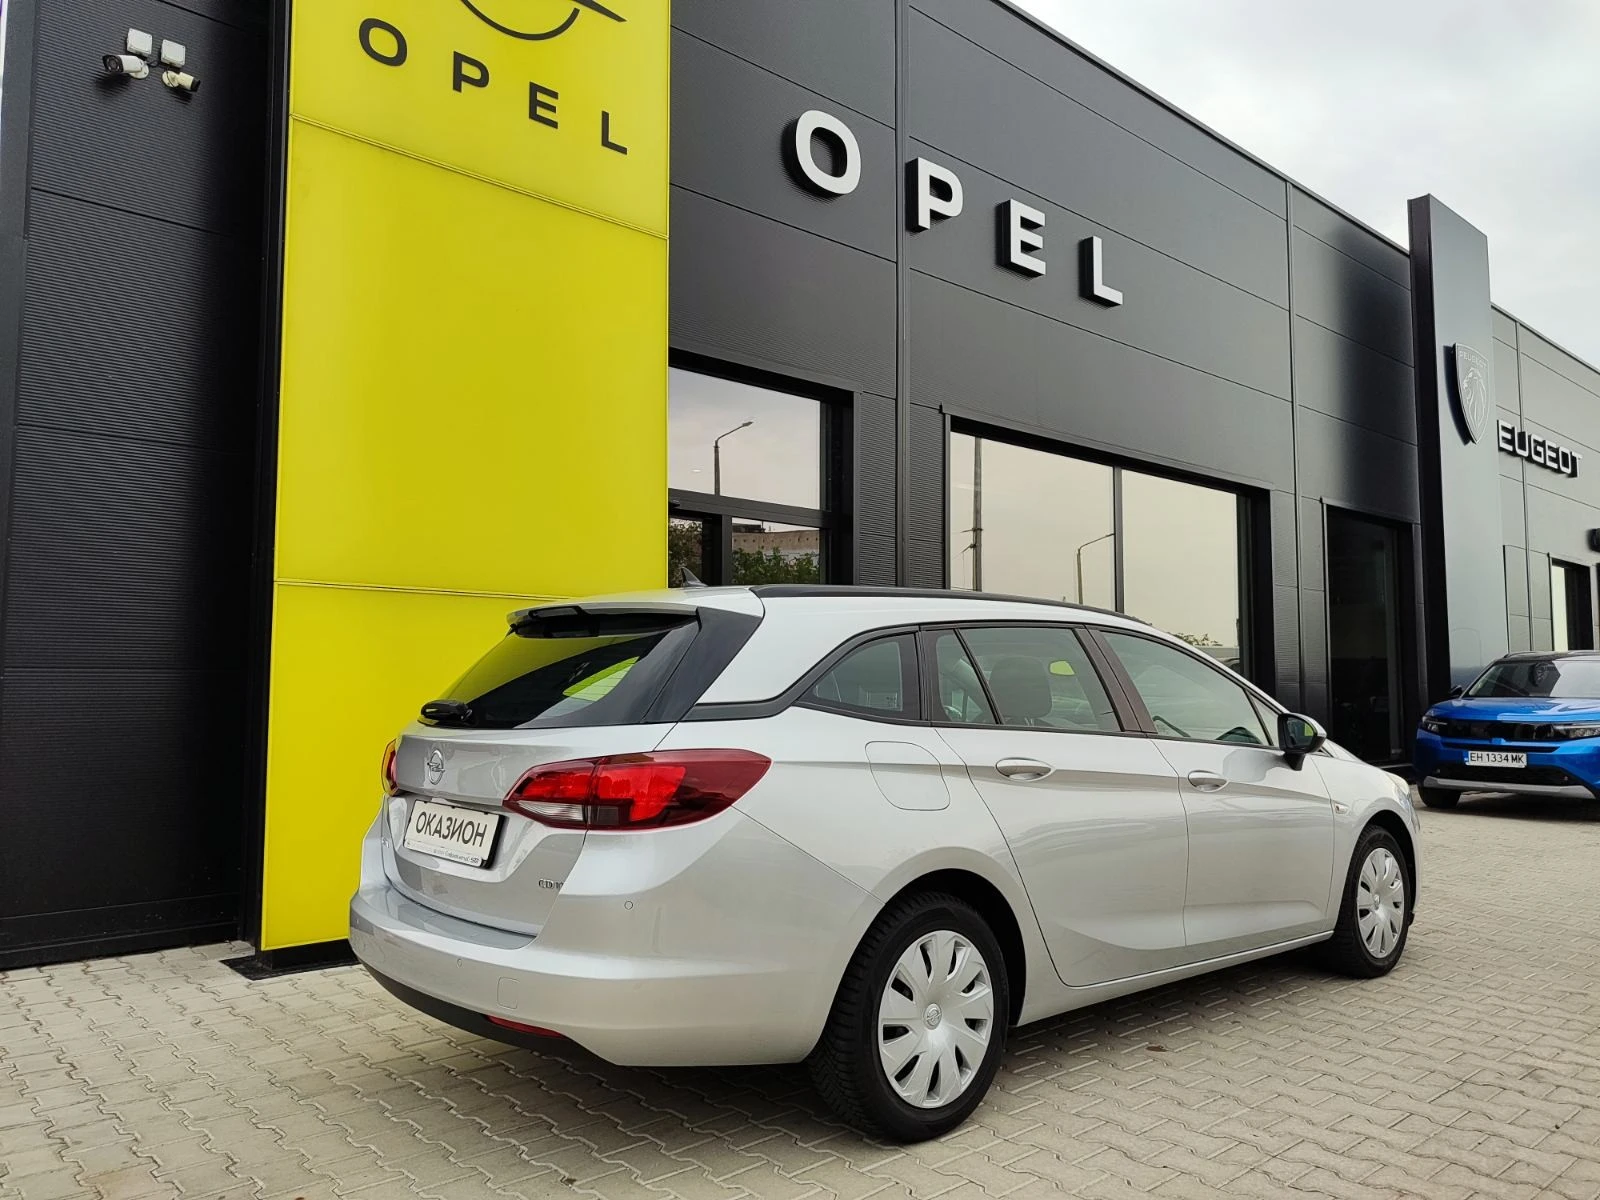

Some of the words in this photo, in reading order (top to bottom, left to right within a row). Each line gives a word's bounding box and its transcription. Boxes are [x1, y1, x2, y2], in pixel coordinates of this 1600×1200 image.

[359, 18, 627, 155] OPEL
[794, 109, 1123, 306] OPEL
[1498, 419, 1583, 478] EUGEOT
[1486, 753, 1509, 763] 1334
[1511, 754, 1525, 764] MK
[416, 811, 487, 847] ОКАЗИОН
